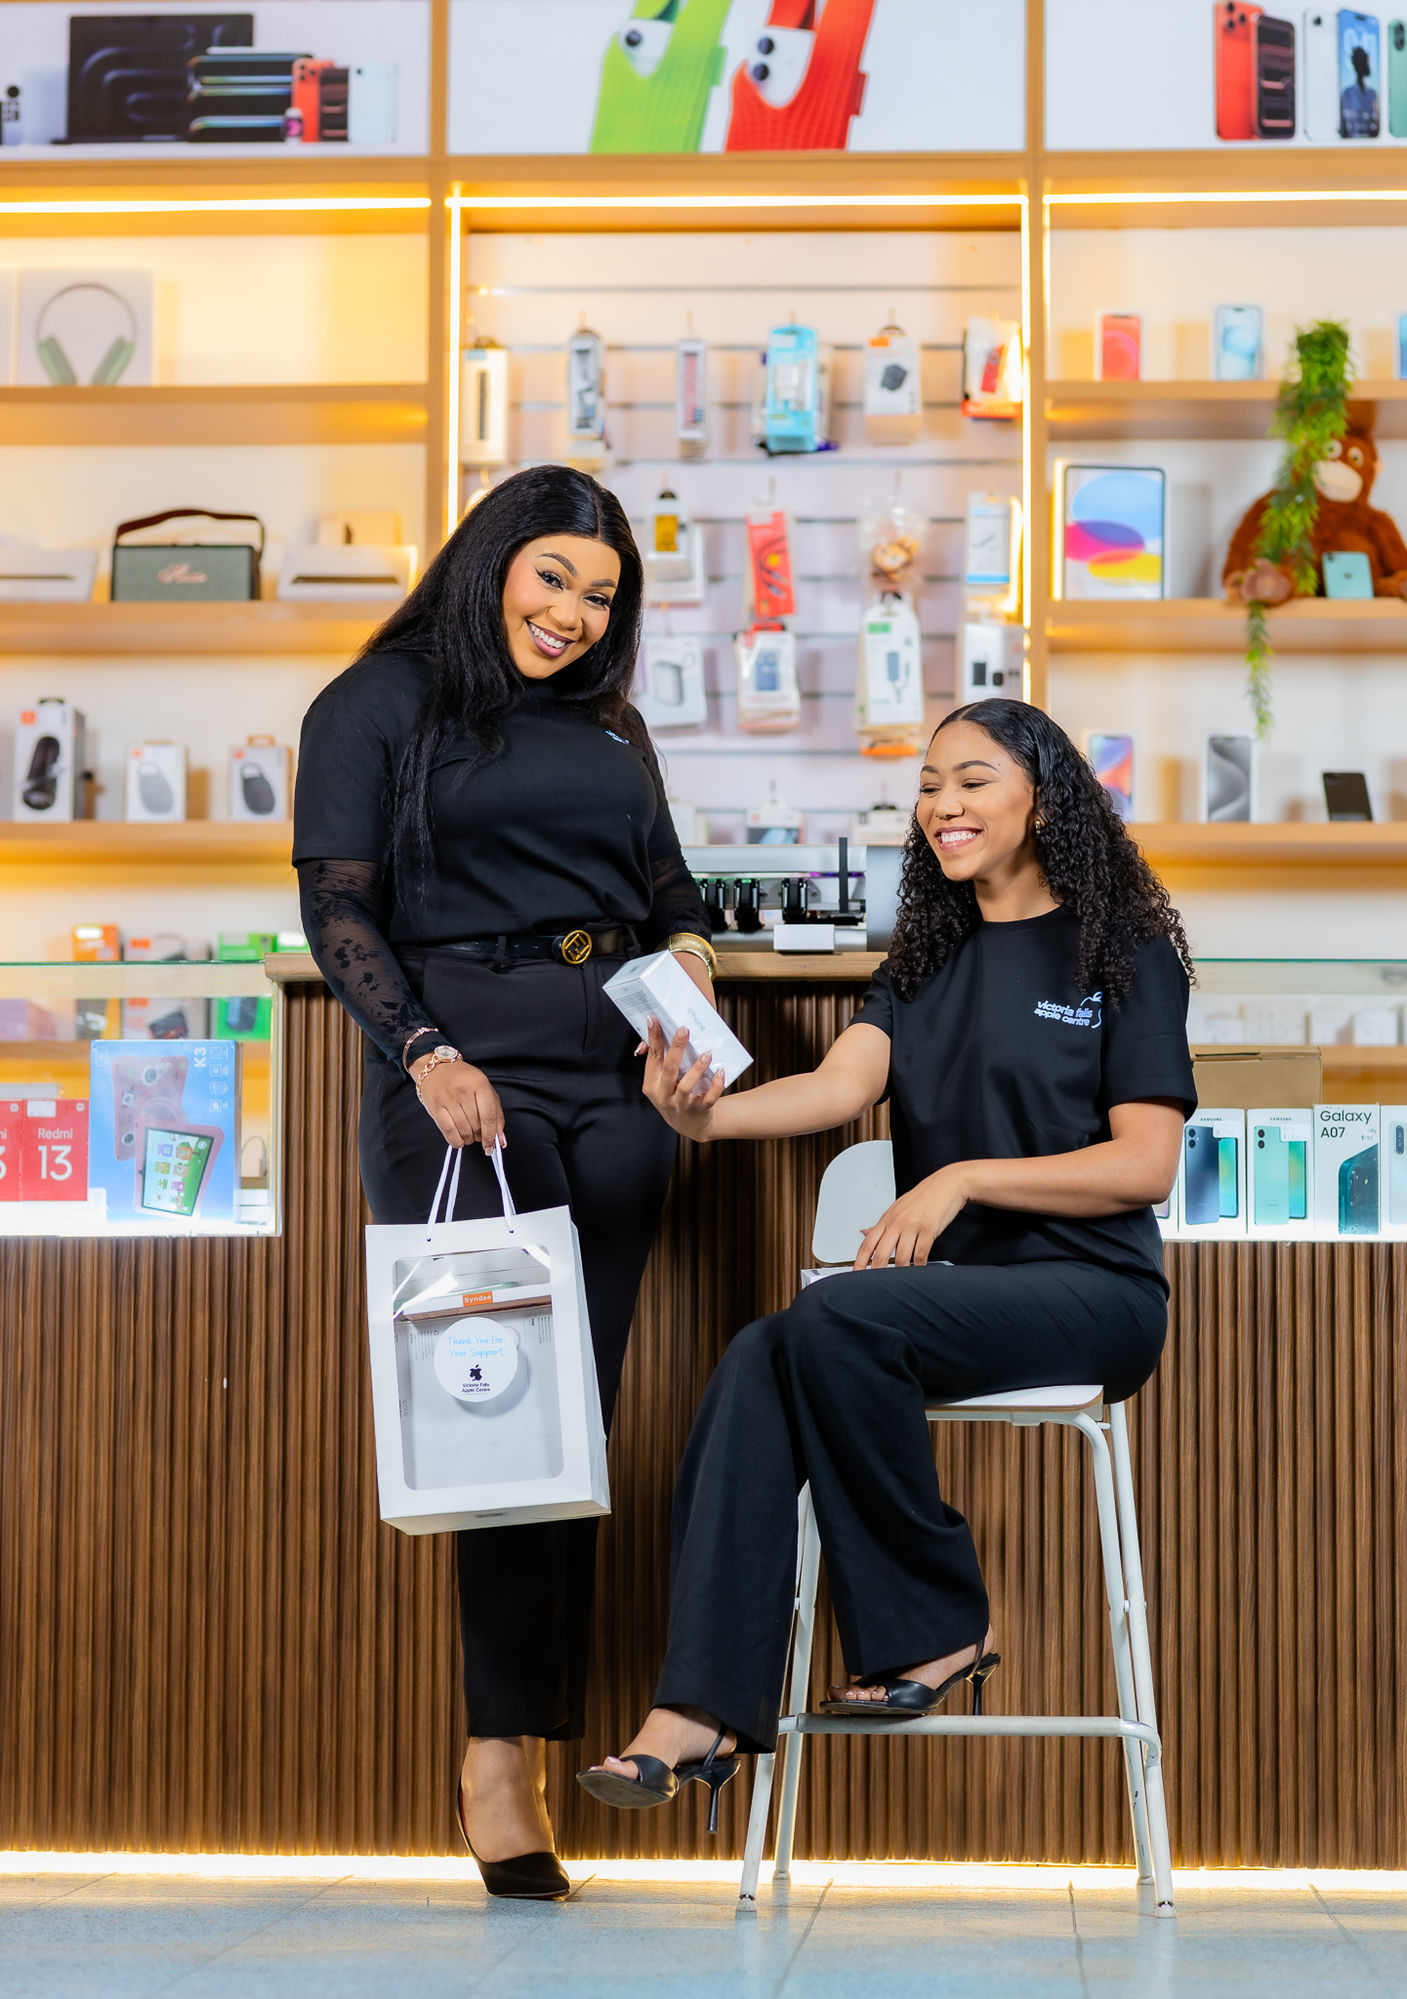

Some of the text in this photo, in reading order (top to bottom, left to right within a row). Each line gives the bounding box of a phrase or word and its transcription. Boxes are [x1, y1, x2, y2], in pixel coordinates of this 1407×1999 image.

[1038, 1000, 1093, 1018] victoria falls
[1033, 1008, 1090, 1026] apple centre
[193, 1047, 207, 1067] K3
[1320, 1110, 1372, 1125] Galaxy
[37, 1127, 73, 1140] Redmi
[1320, 1126, 1346, 1138] A07
[37, 1145, 73, 1181] 13
[448, 1334, 503, 1345] Thank You For
[449, 1347, 503, 1358] Your Support
